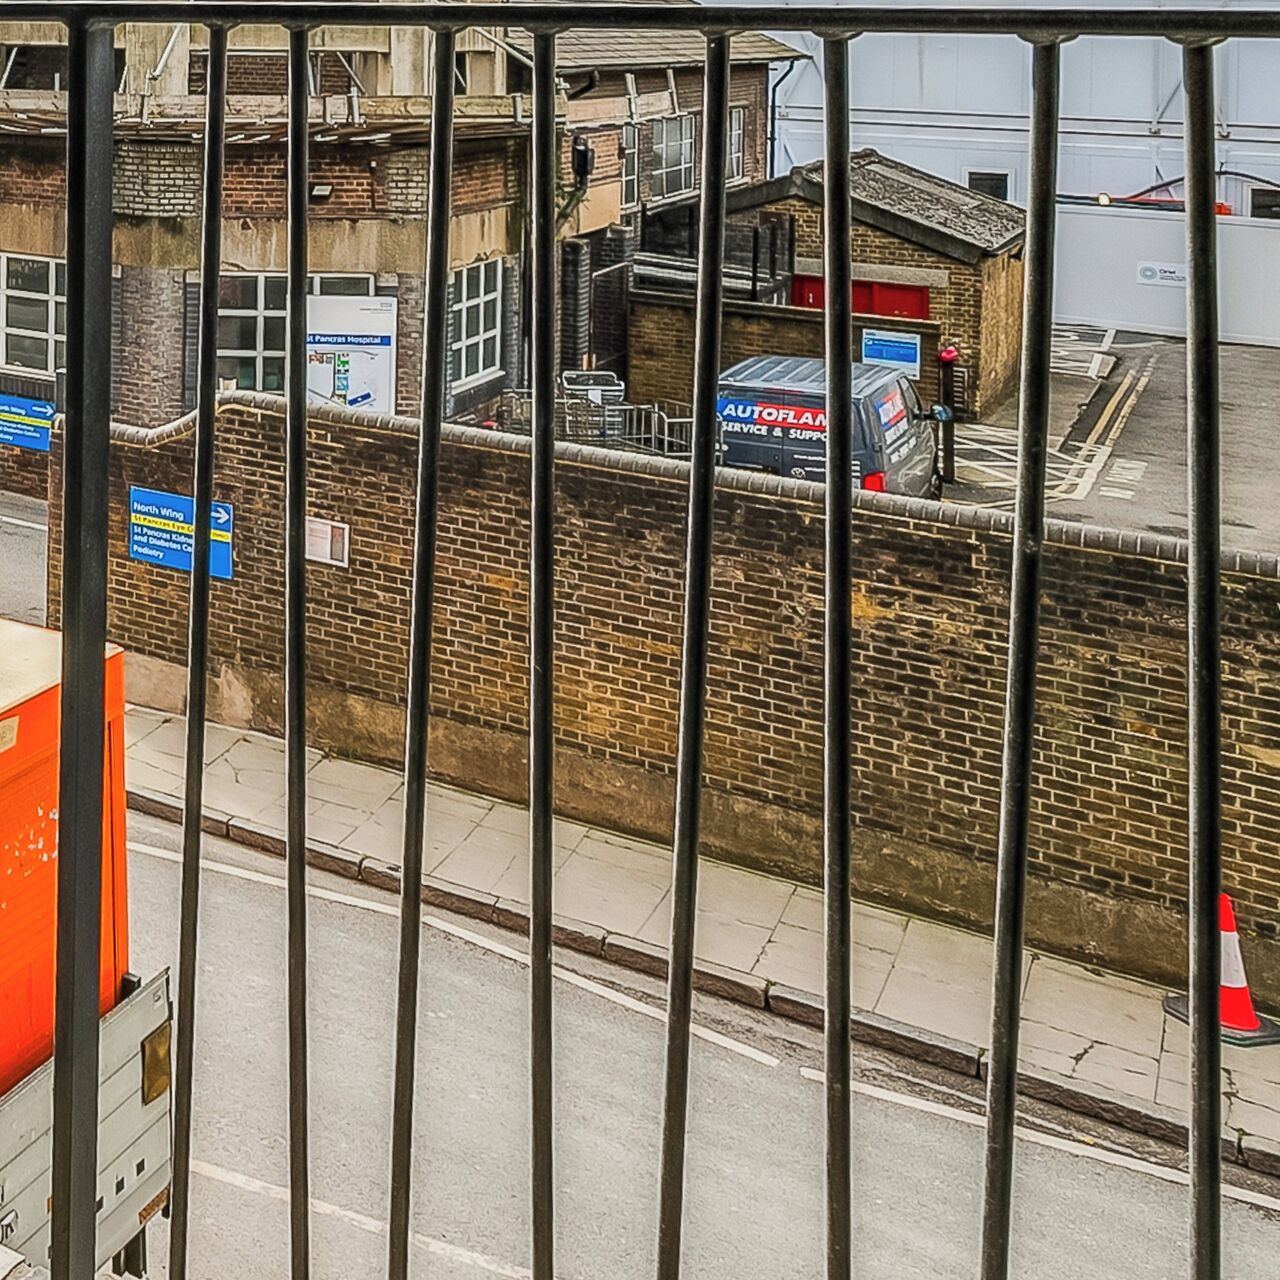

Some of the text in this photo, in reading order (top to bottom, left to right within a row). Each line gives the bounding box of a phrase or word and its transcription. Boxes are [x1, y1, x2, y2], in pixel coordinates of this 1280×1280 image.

[314, 335, 346, 343] Pancras
[347, 336, 381, 345] Hospital
[722, 421, 828, 442] SERVICE & SUPPO
[133, 501, 184, 522] North Wing
[134, 525, 141, 534] St
[142, 527, 171, 540] Pancras
[133, 534, 148, 544] and
[148, 537, 181, 550] Diabetes
[133, 544, 164, 560] Podiatry
